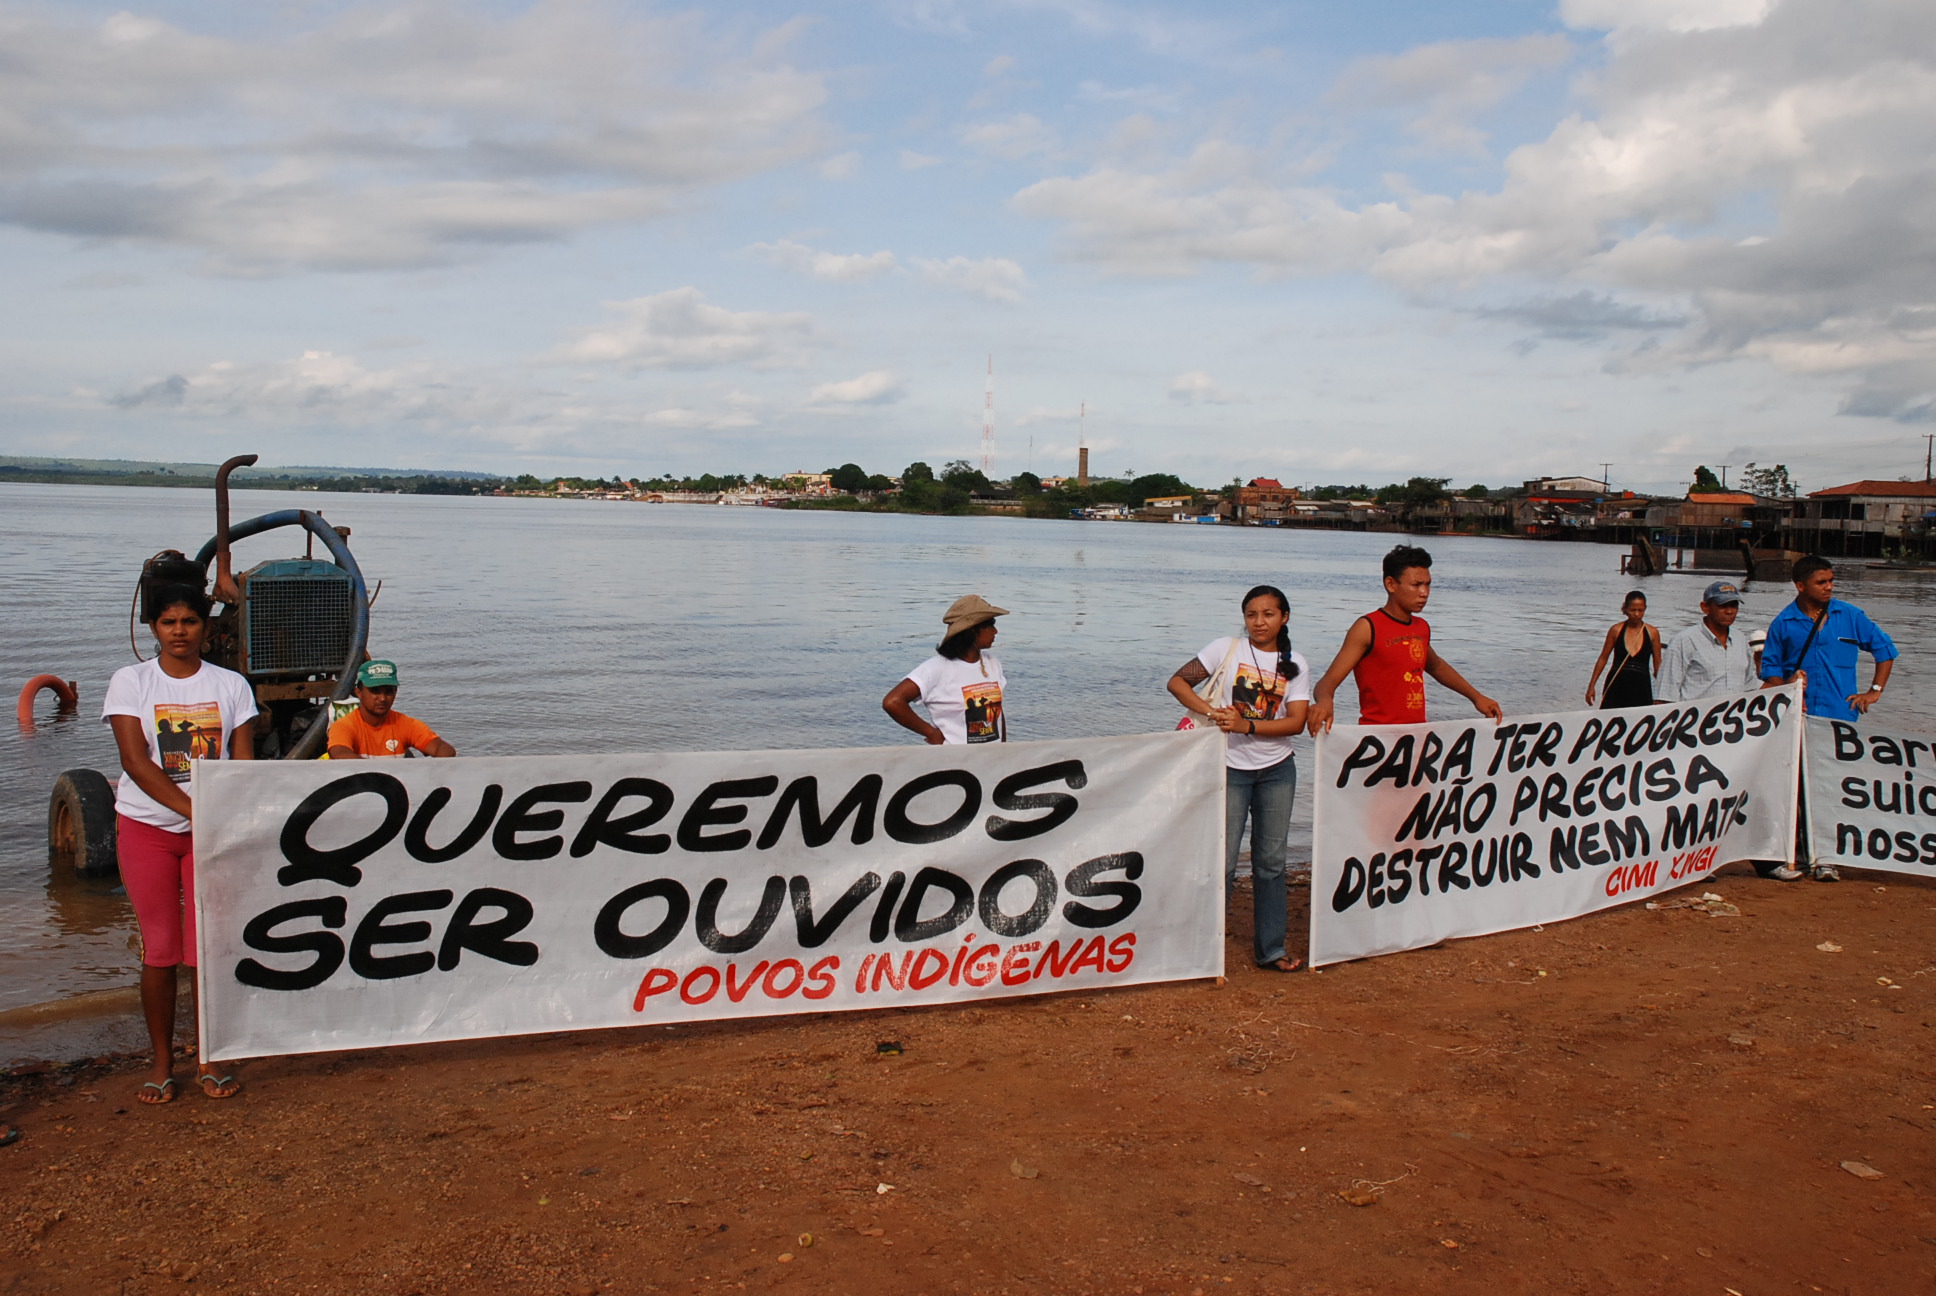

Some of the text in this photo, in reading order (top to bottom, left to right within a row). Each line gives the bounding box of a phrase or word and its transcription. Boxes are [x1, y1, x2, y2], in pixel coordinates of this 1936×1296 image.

[1337, 728, 1476, 788] PARA
[1487, 722, 1563, 777] TER
[1830, 721, 1936, 768] Bar
[277, 760, 1087, 888] QUEREMOS
[1395, 755, 1729, 842] NÃO PRECISA
[1332, 832, 1541, 913] DESTRUIR
[1550, 815, 1650, 874] NEM
[1605, 859, 1659, 897] CIMI
[234, 851, 1144, 991] SER OUVIDOS
[632, 932, 1138, 1013] POVOS INDÍGENAS
